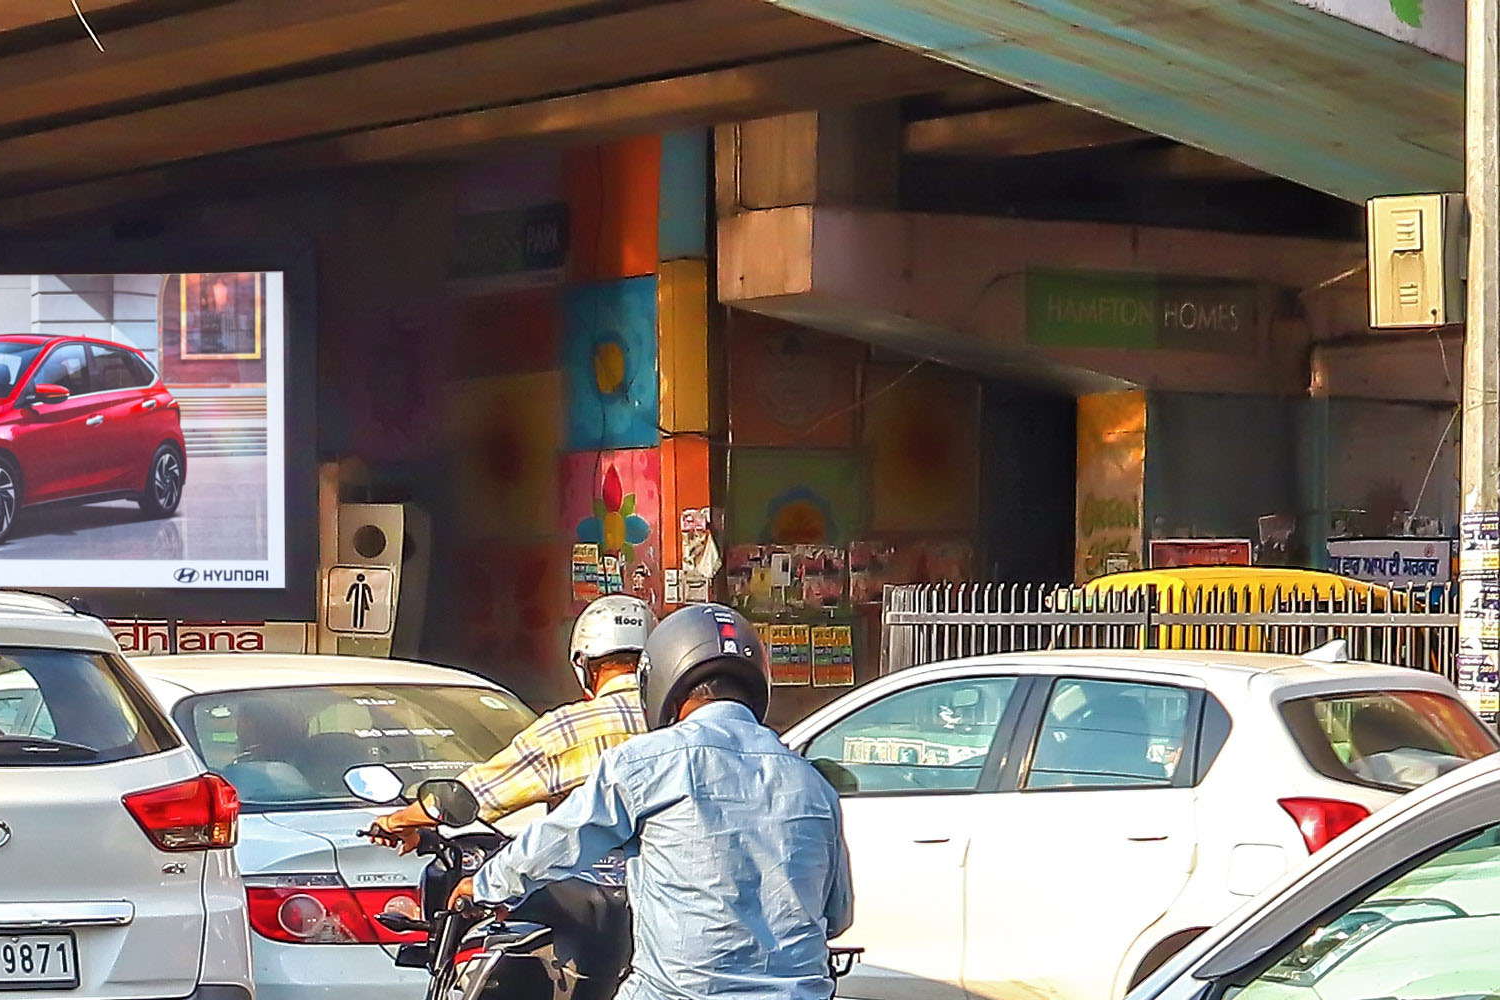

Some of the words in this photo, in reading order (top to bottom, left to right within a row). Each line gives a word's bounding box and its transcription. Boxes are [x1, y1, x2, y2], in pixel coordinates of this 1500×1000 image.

[203, 570, 269, 581] HYUNDAI
[115, 624, 264, 651] dhana
[2, 943, 68, 974] 9871
